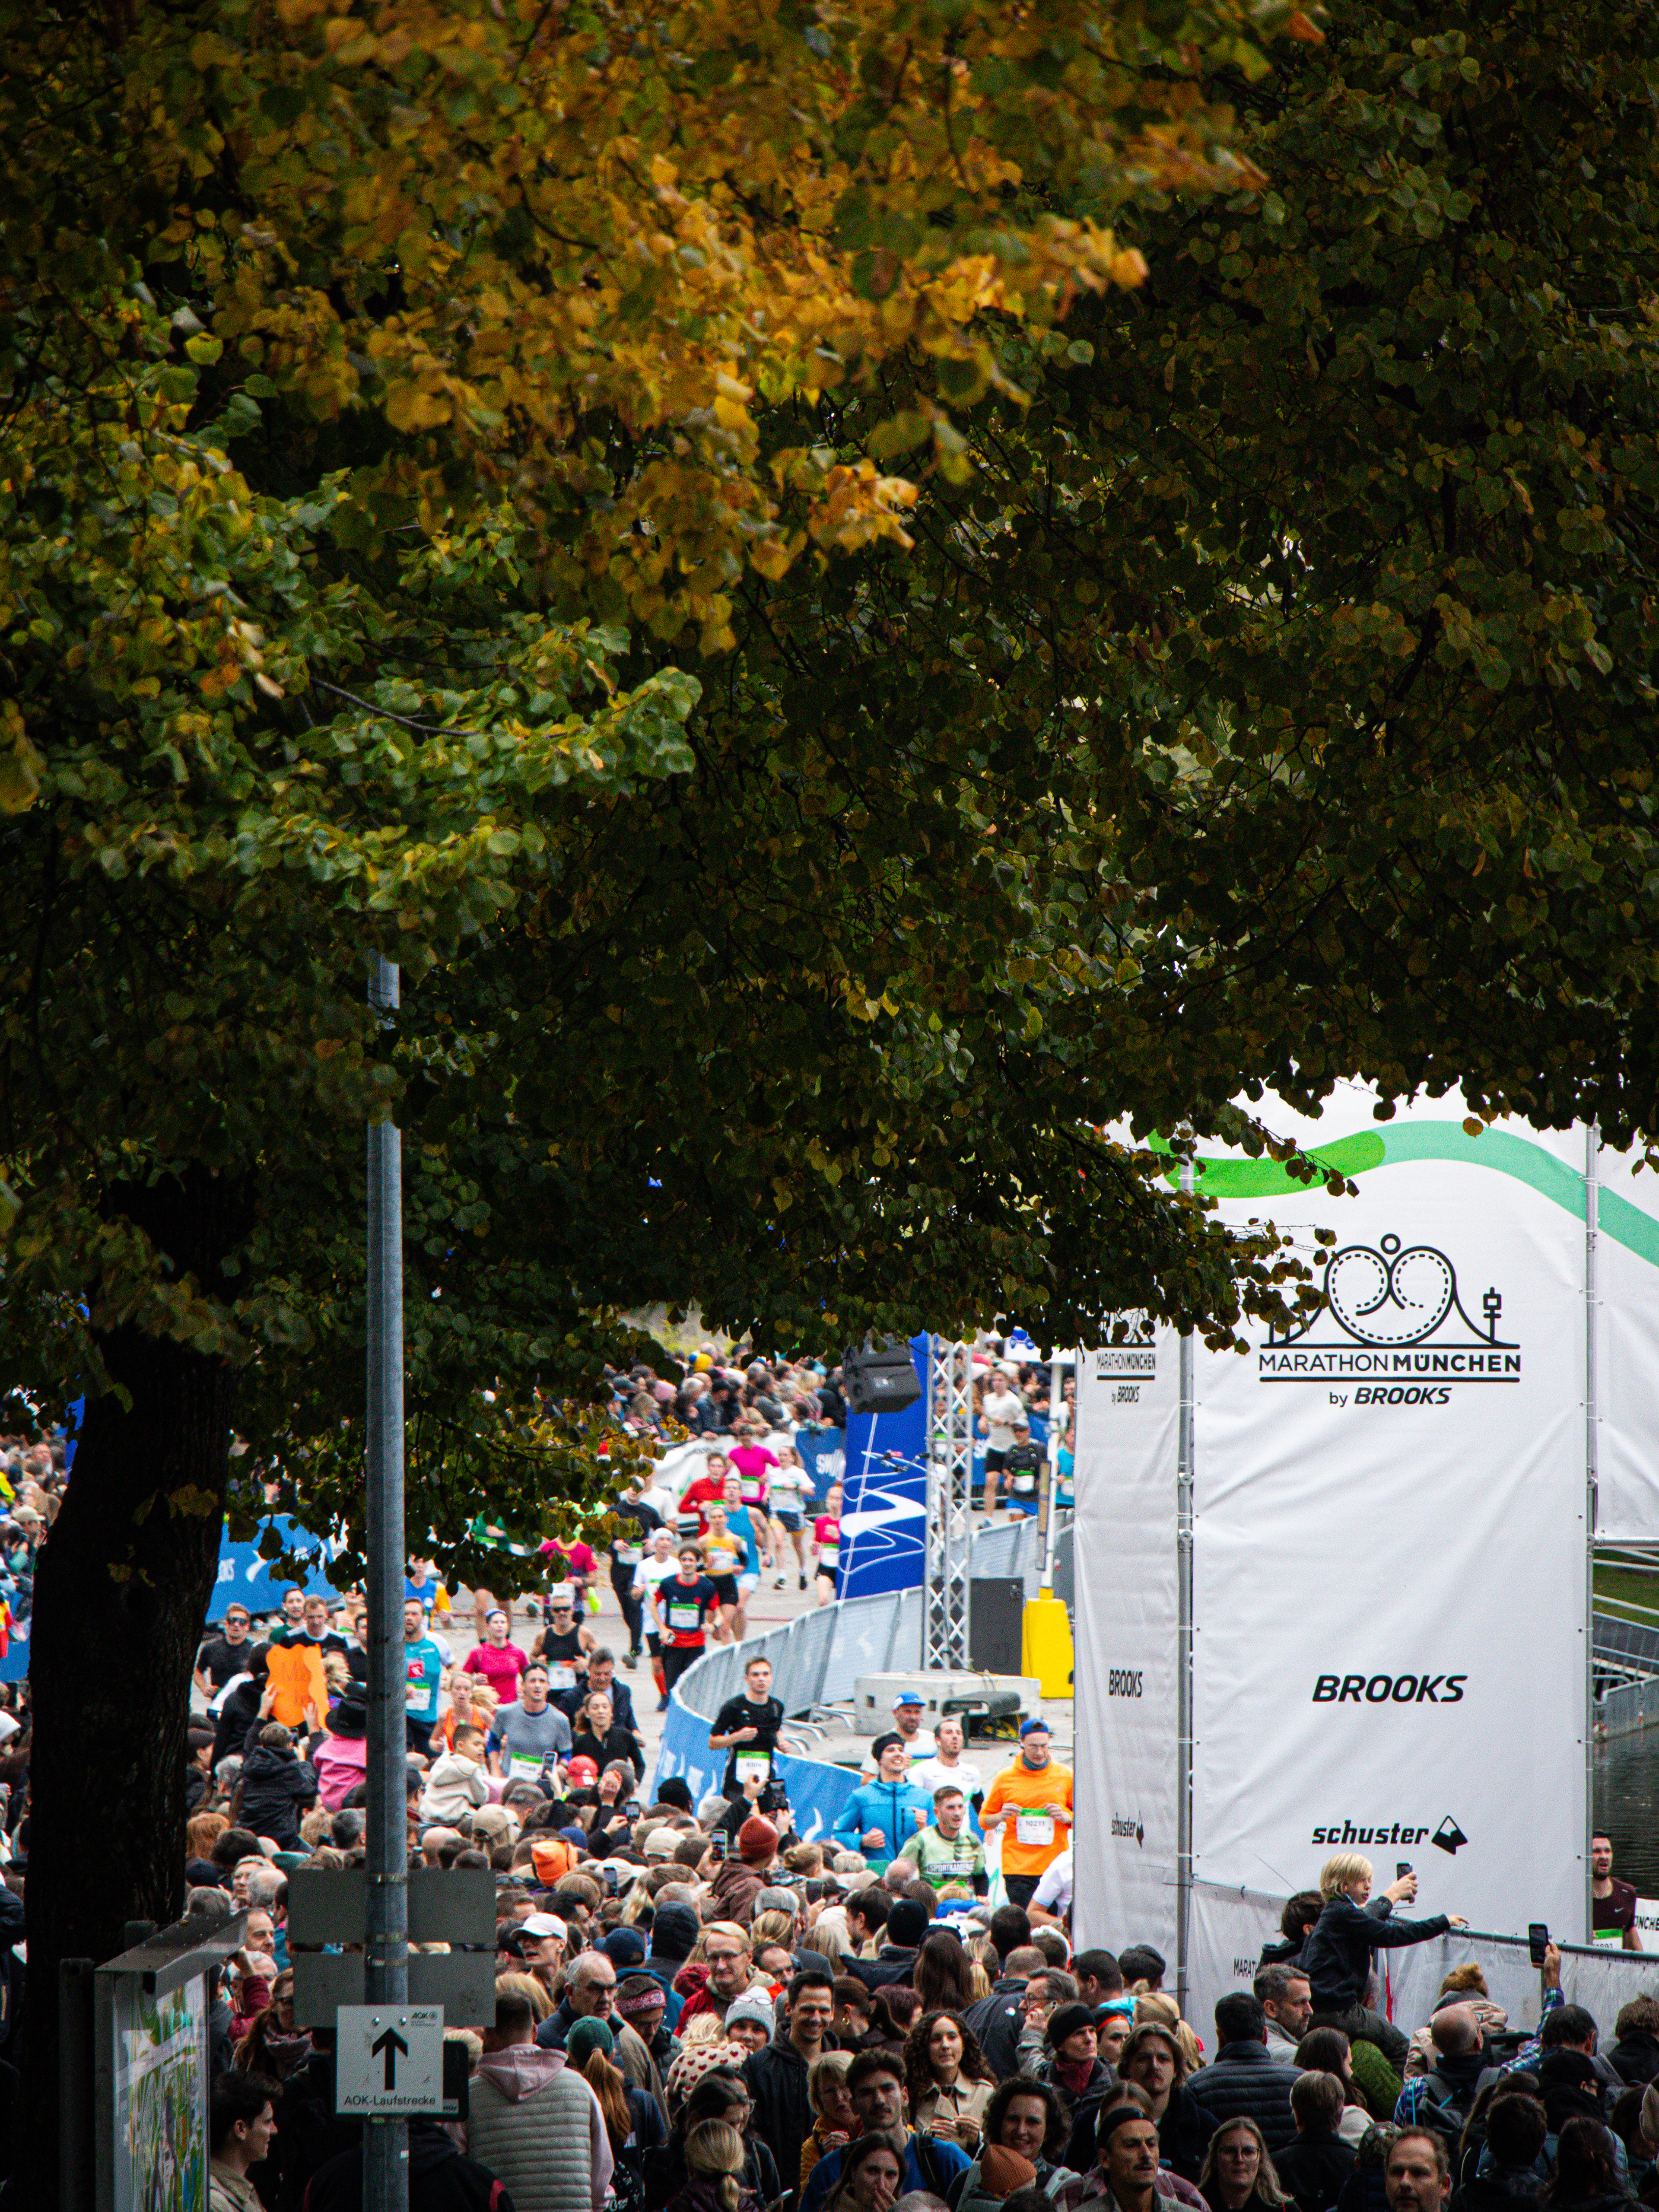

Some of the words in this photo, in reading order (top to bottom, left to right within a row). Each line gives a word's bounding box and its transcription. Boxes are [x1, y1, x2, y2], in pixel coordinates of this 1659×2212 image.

[1111, 1391, 1116, 1405] by
[1117, 1386, 1140, 1403] BROOKS
[1329, 1391, 1348, 1408] by
[1354, 1387, 1452, 1405] BROOKS
[1109, 1669, 1143, 1697] BROOKS
[1313, 1675, 1468, 1703] BROOKS
[1111, 1813, 1136, 1837] schuster
[1312, 1820, 1429, 1844] schuster
[411, 2012, 428, 2020] AOK
[344, 2095, 436, 2106] AOK-Laufstrecke
